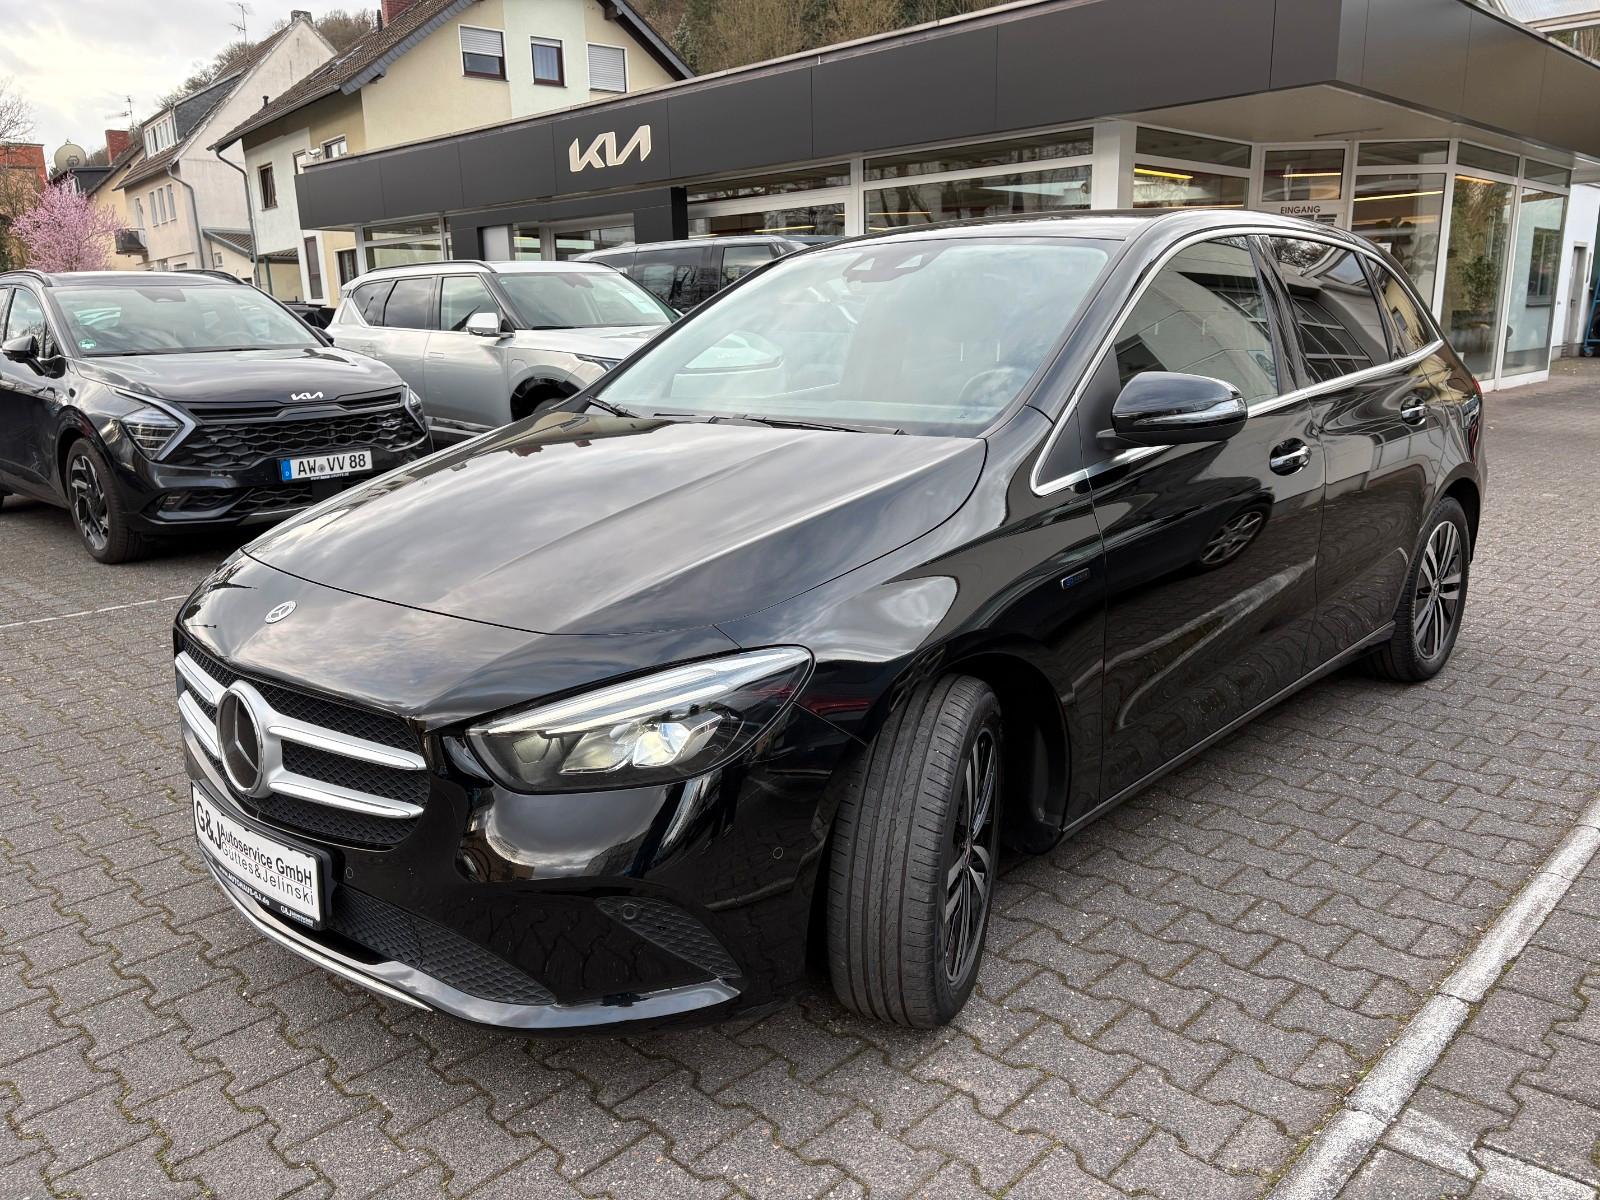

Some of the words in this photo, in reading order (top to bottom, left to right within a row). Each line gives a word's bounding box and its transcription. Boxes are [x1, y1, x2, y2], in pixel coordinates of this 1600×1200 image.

[1280, 206, 1320, 214] EINGANG
[327, 456, 346, 471] VV
[349, 453, 366, 468] 88
[221, 824, 273, 868] Autoservice
[275, 857, 313, 888] GmbH
